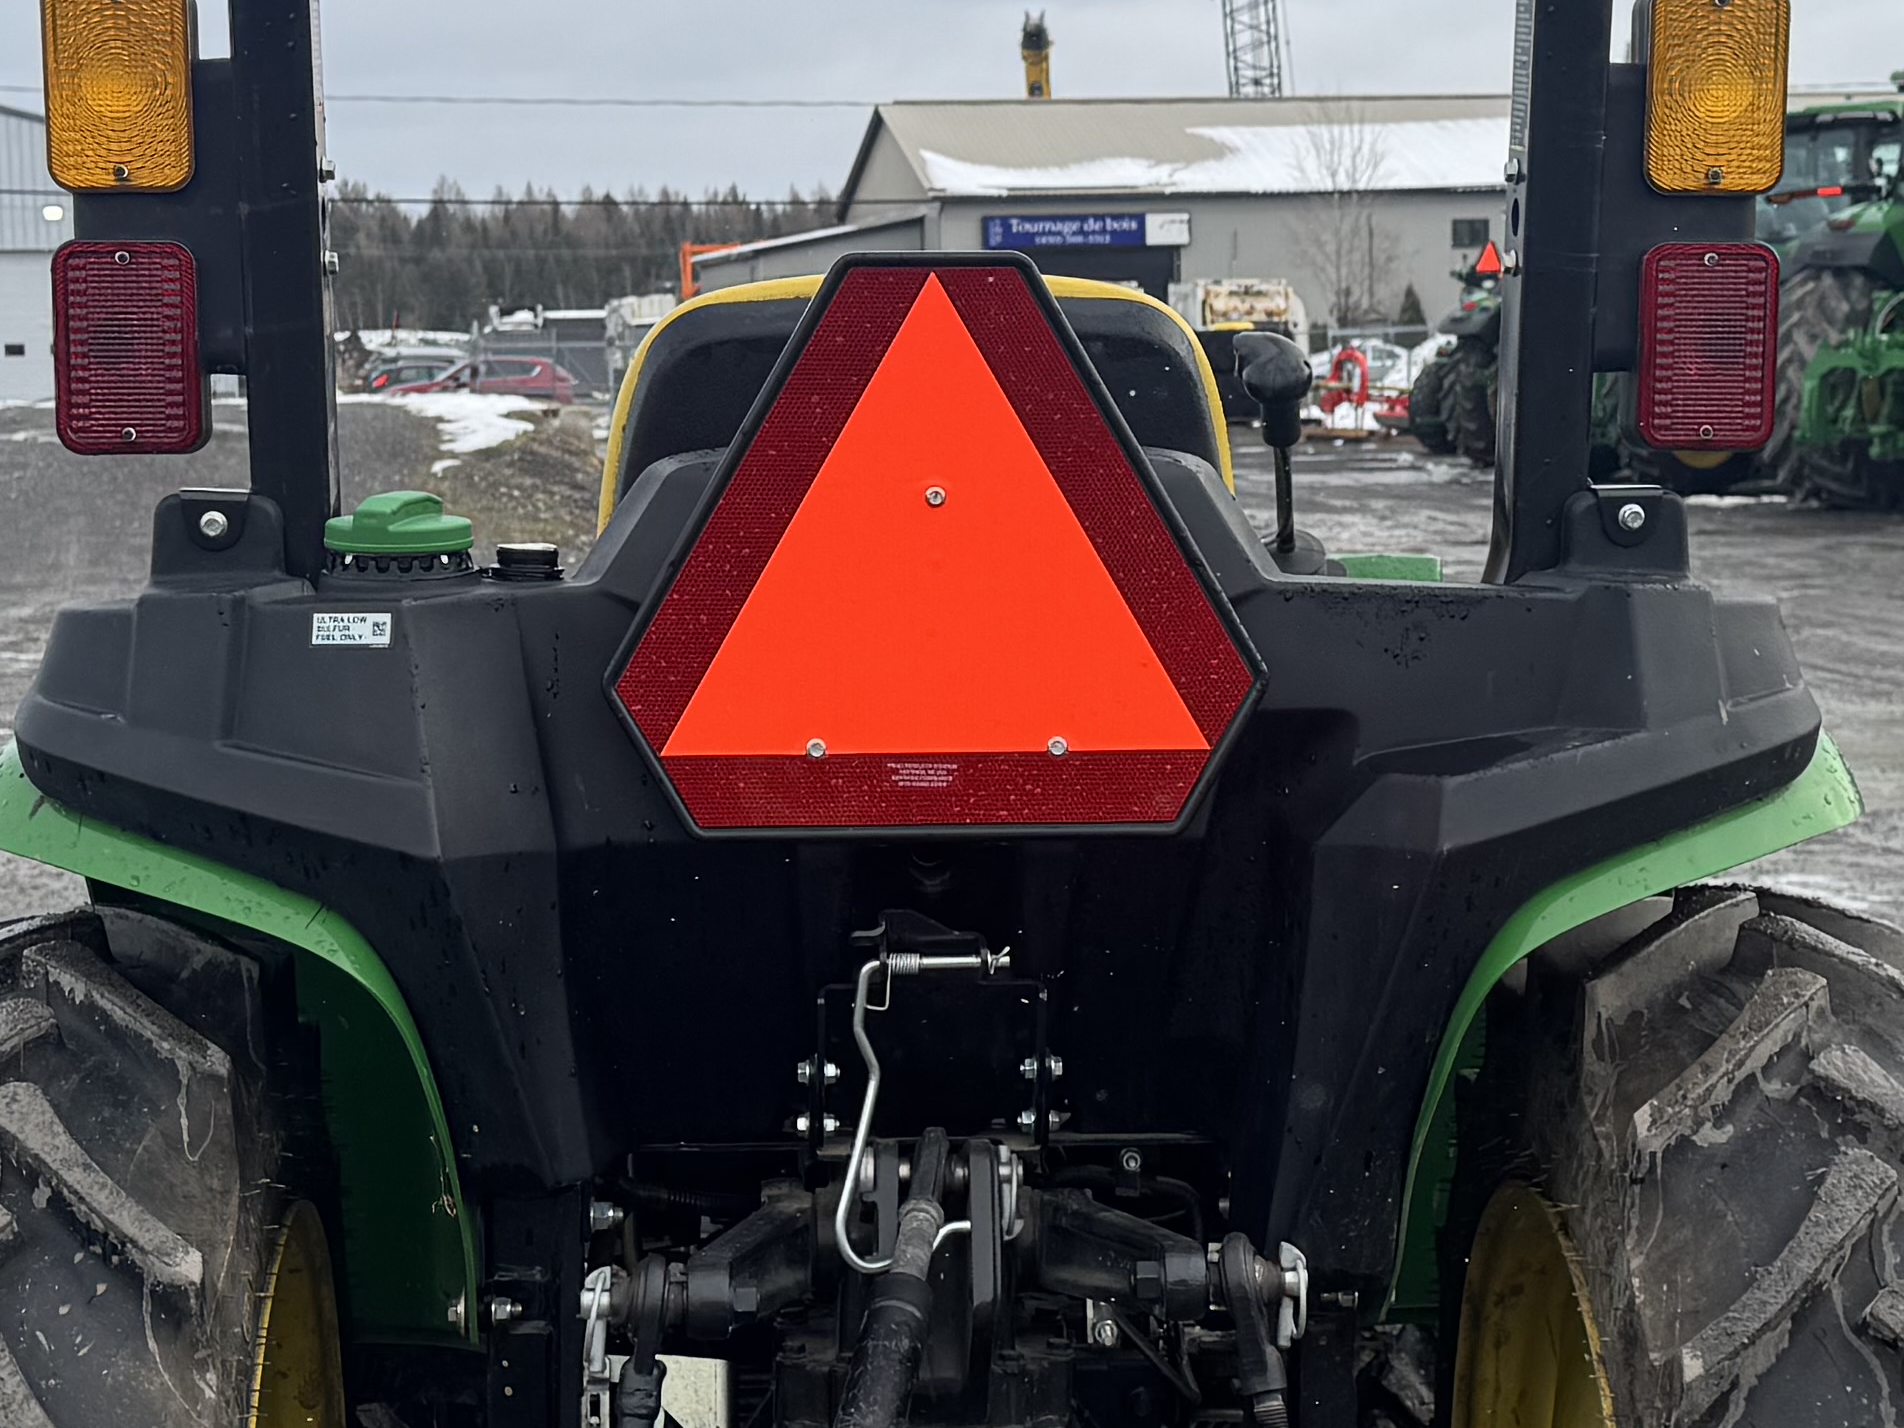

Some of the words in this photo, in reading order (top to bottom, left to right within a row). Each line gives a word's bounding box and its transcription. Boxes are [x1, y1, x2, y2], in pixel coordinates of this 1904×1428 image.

[1009, 218, 1080, 237] Tournage
[1083, 218, 1103, 232] de
[1105, 217, 1138, 232] bois
[347, 616, 367, 624] LOW
